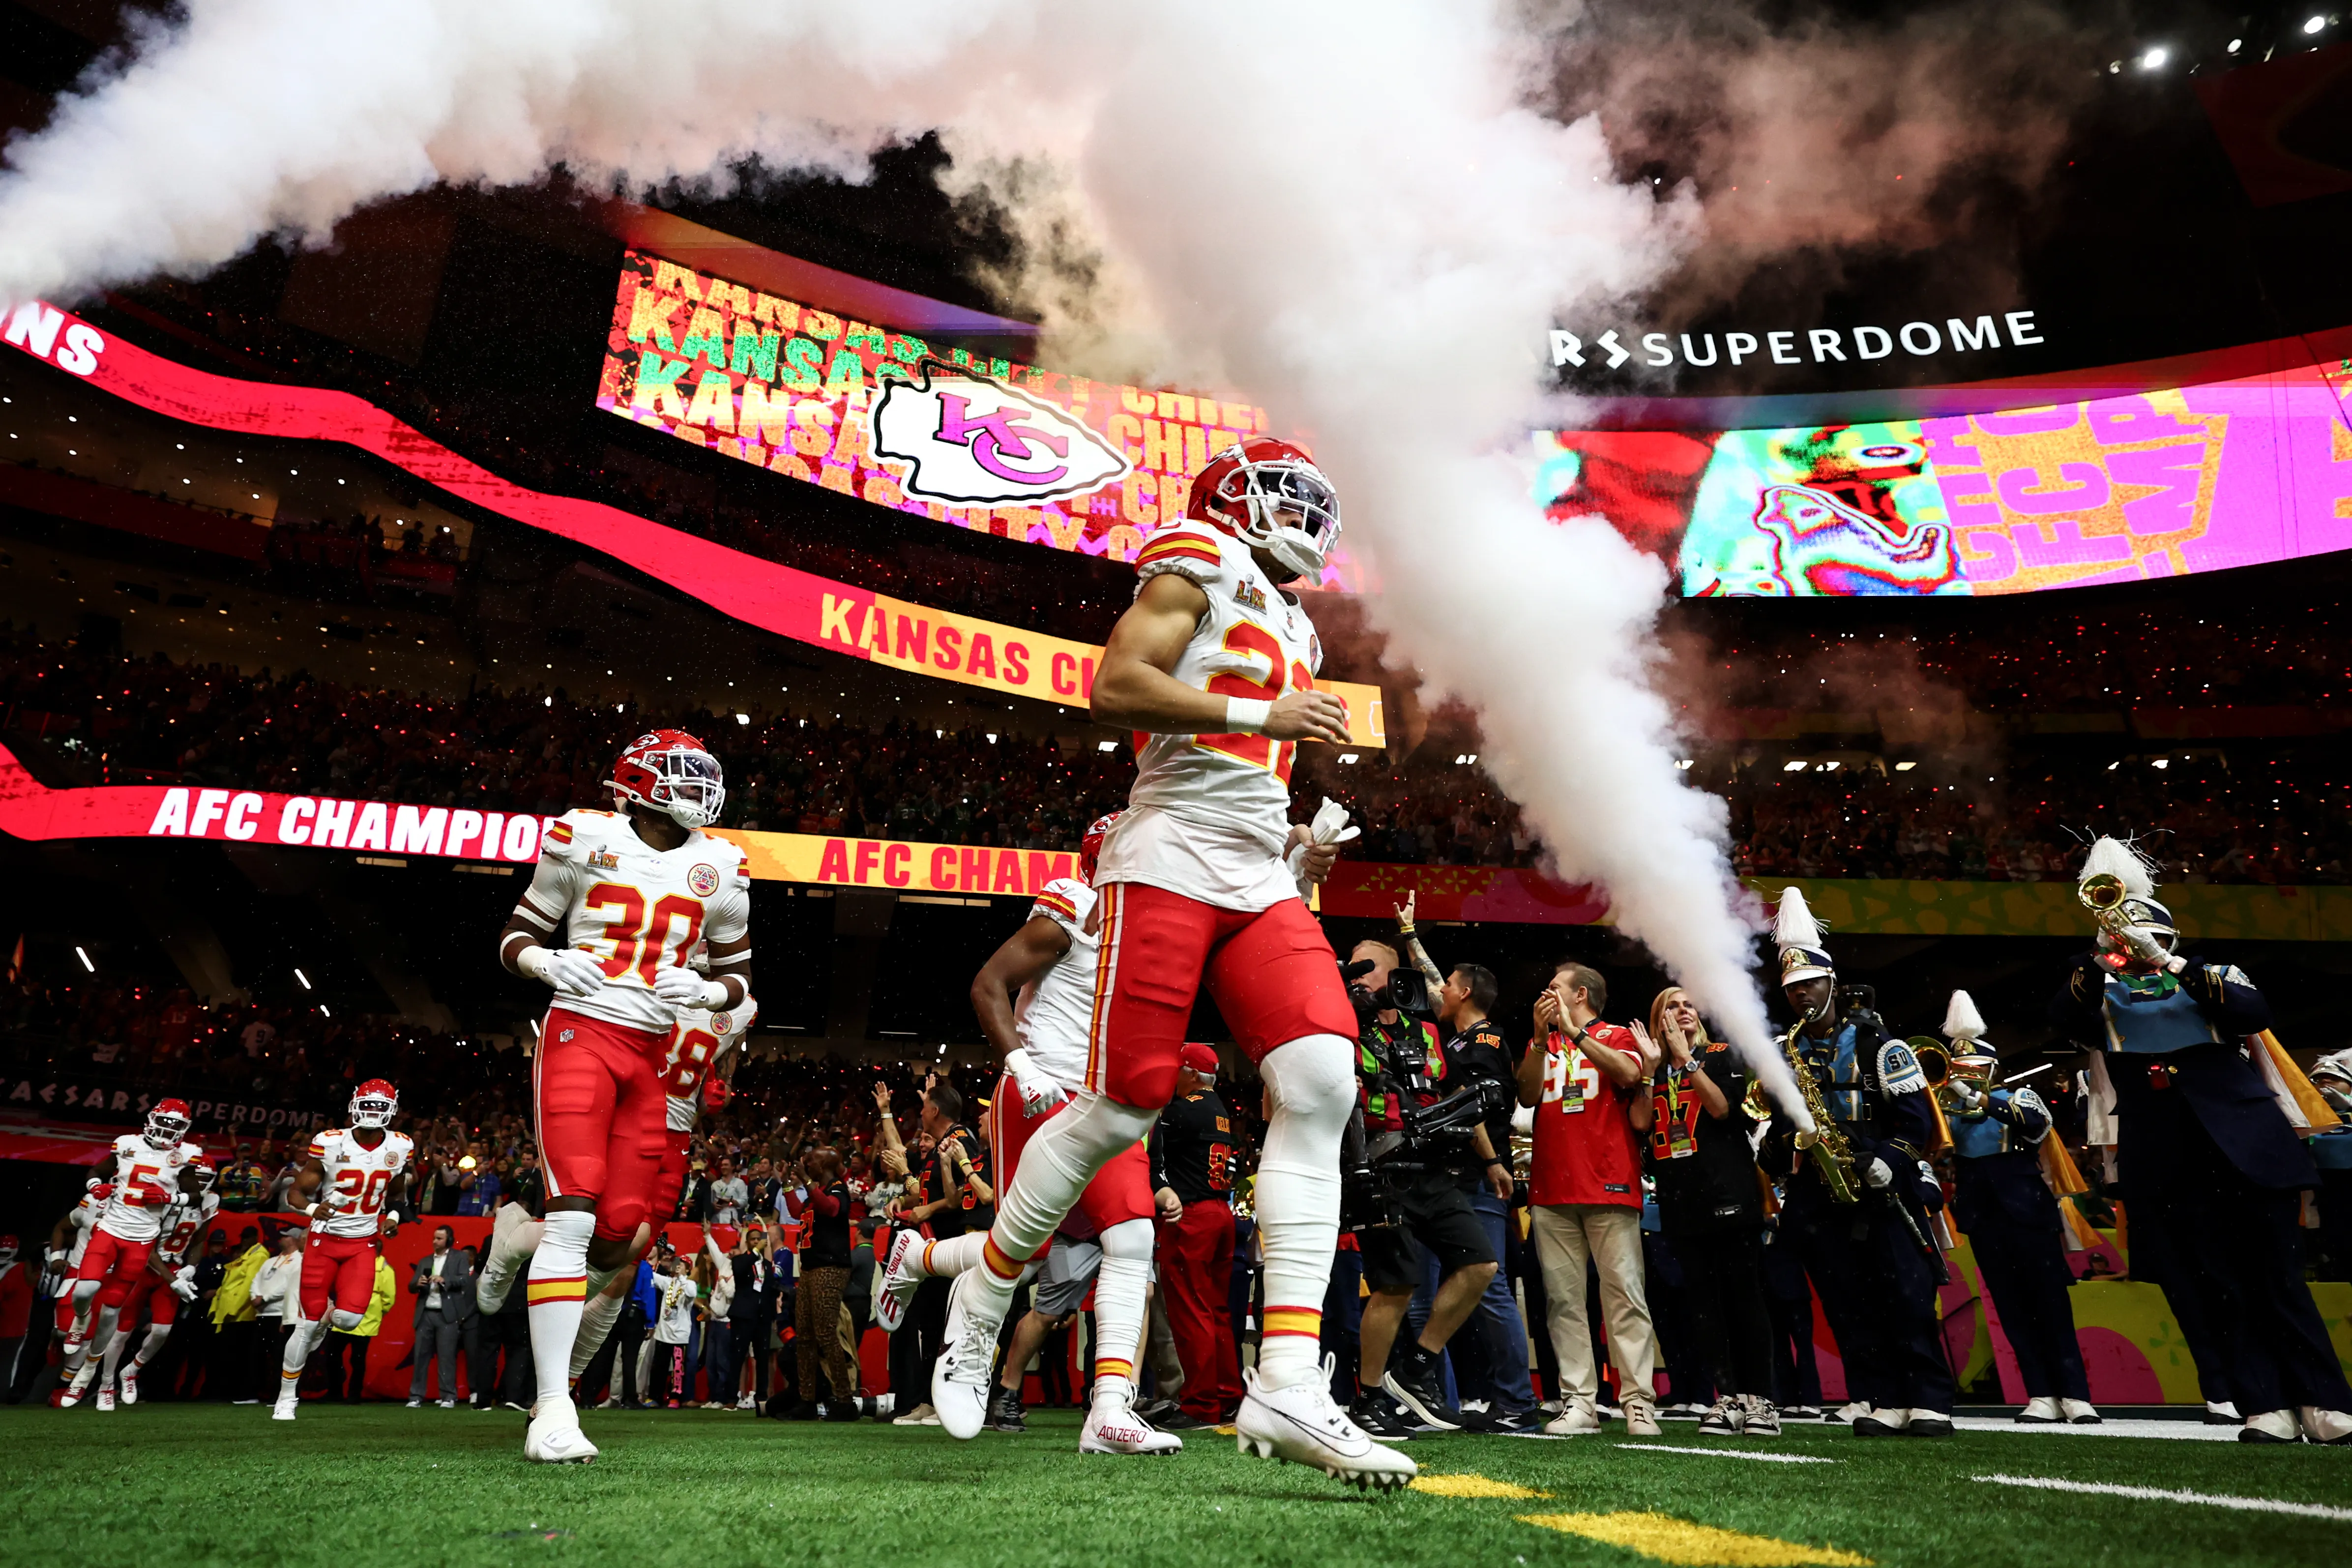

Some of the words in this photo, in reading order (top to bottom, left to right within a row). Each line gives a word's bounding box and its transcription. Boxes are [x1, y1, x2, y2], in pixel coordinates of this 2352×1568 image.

[0, 301, 105, 376] NS
[1641, 310, 2045, 367] SUPERDOME
[932, 392, 1070, 485] KC
[820, 592, 1029, 685] KANSAS
[148, 788, 263, 840] AFC
[818, 839, 911, 886] AFC
[930, 847, 1082, 895] CHAM
[578, 881, 706, 989] 30
[1475, 1033, 1500, 1048] 15
[1886, 1049, 1910, 1071] SU
[2, 1079, 149, 1114] AESARS
[123, 1164, 160, 1207] 5
[333, 1169, 392, 1215] 20
[1097, 1425, 1147, 1444] ADIZERO
